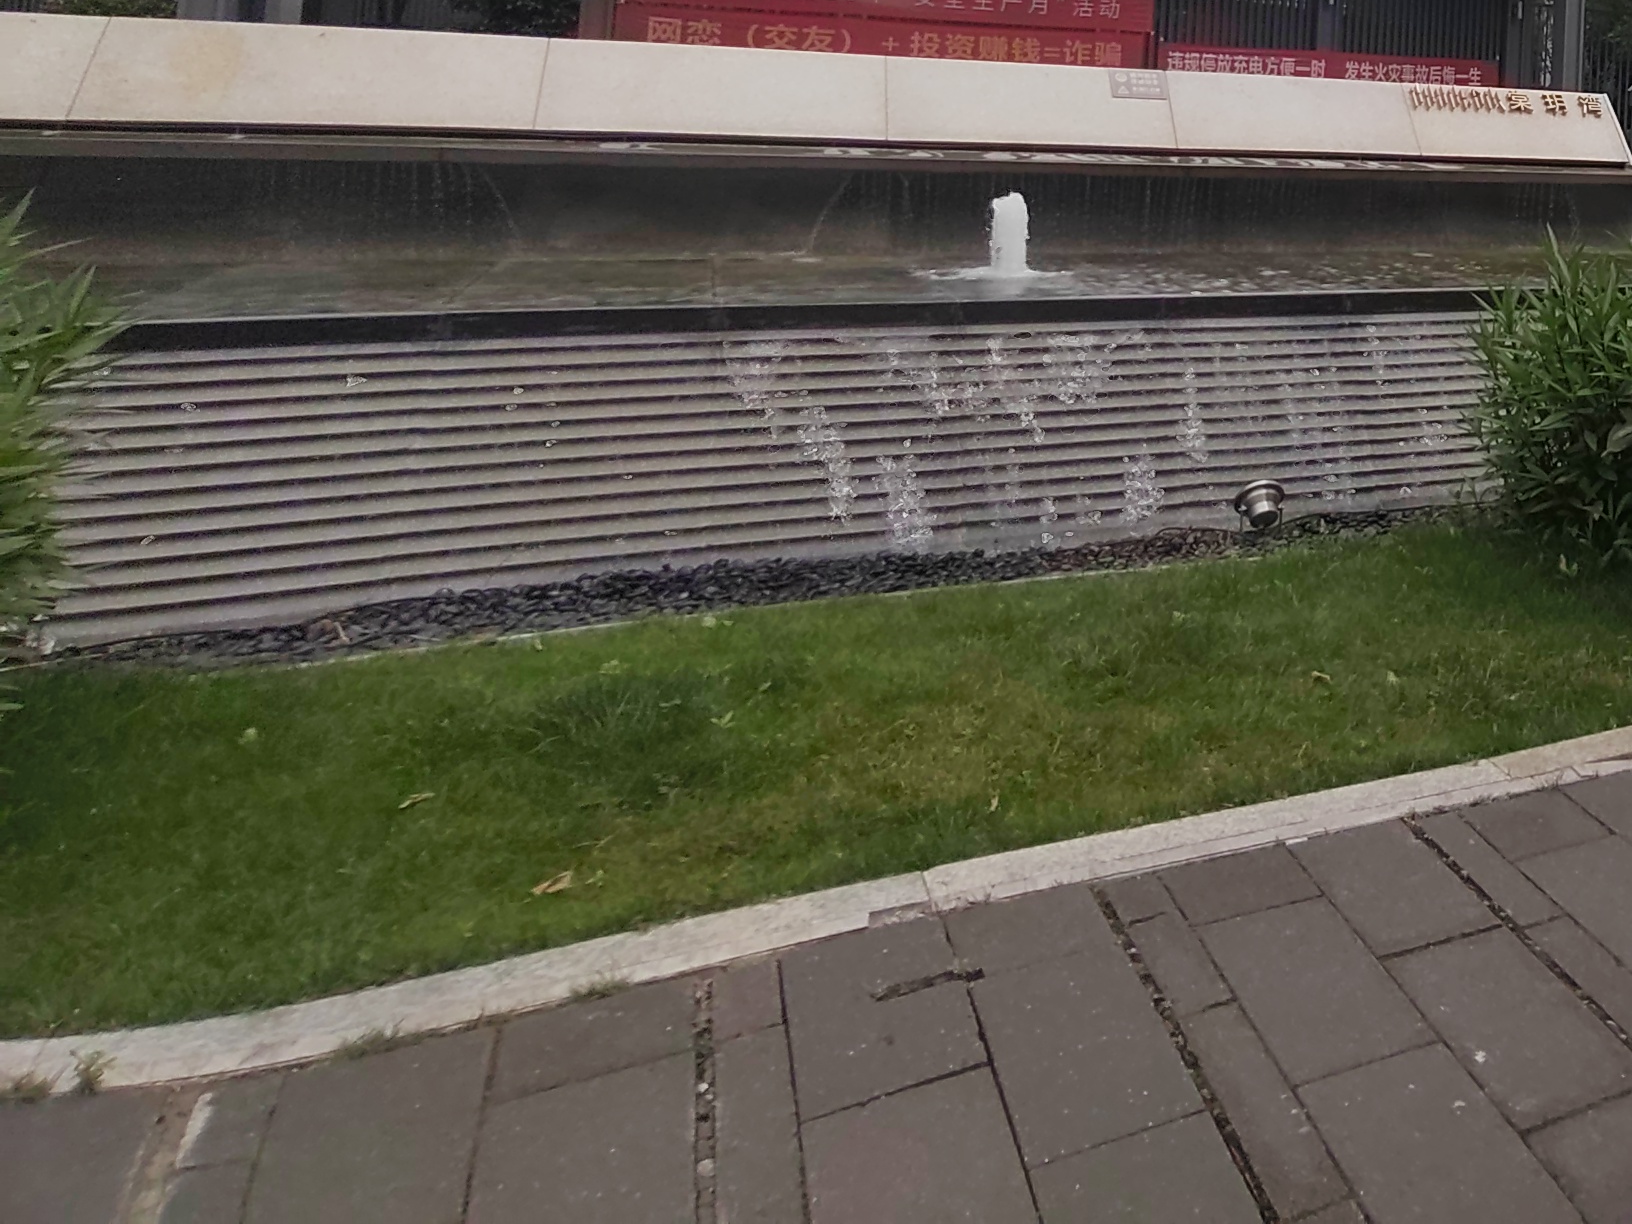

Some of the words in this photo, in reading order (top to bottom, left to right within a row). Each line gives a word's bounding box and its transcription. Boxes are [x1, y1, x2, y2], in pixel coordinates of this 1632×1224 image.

[1167, 51, 1326, 78] 违规停放充电方便一时
[1345, 60, 1482, 86] 发生火灾事故后悔一生
